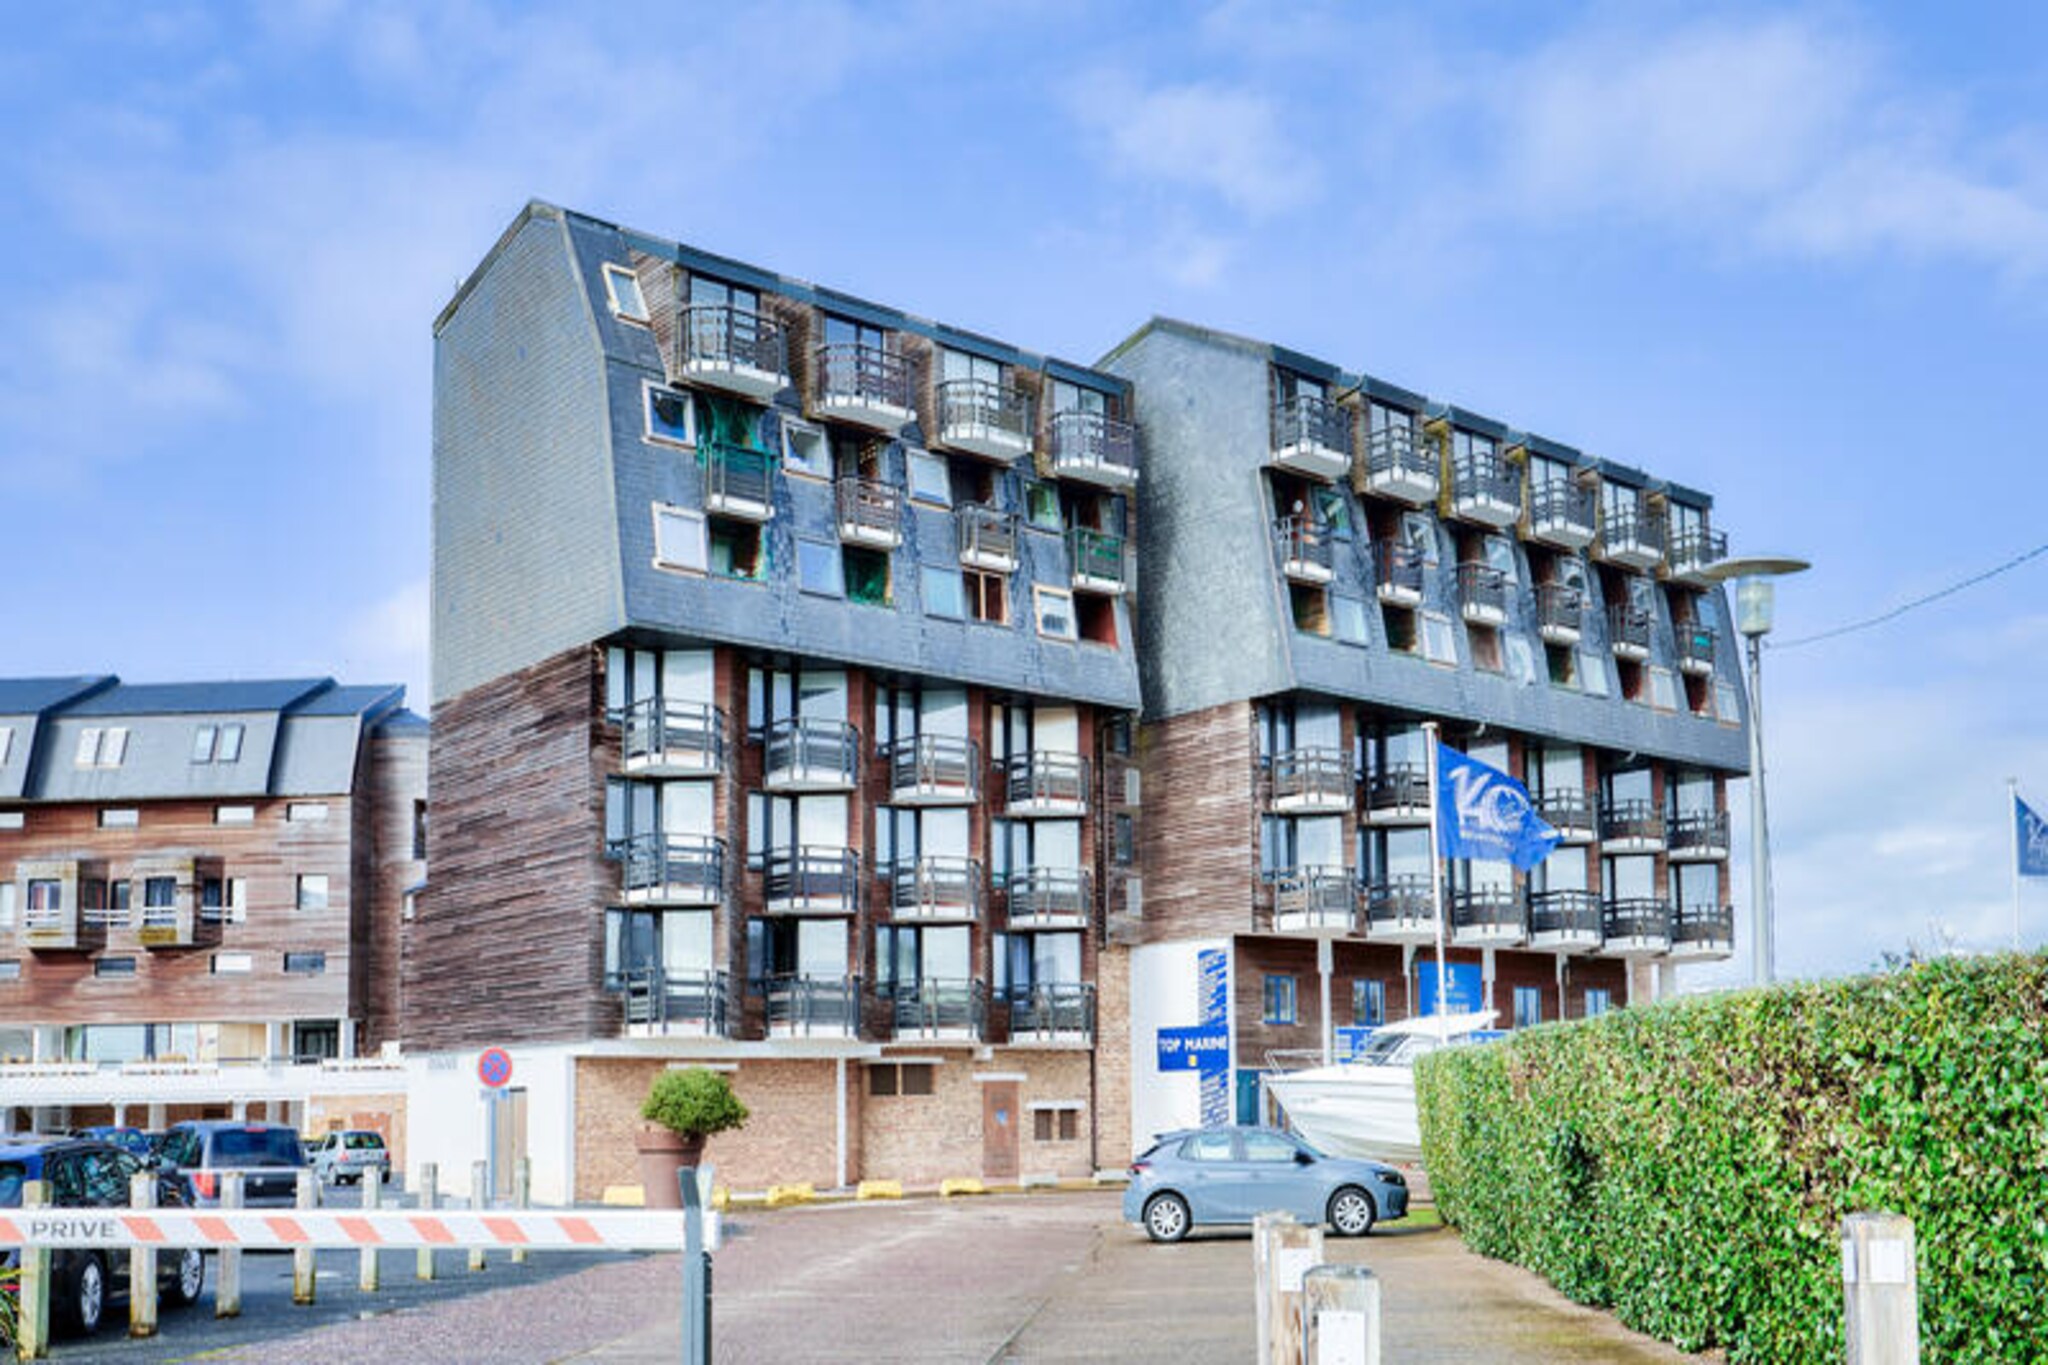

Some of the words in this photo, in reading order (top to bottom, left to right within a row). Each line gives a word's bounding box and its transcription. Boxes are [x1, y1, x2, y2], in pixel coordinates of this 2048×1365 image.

[1159, 1037, 1181, 1053] TOP
[1185, 1035, 1227, 1052] MARINE
[32, 1220, 117, 1238] PRIVE
